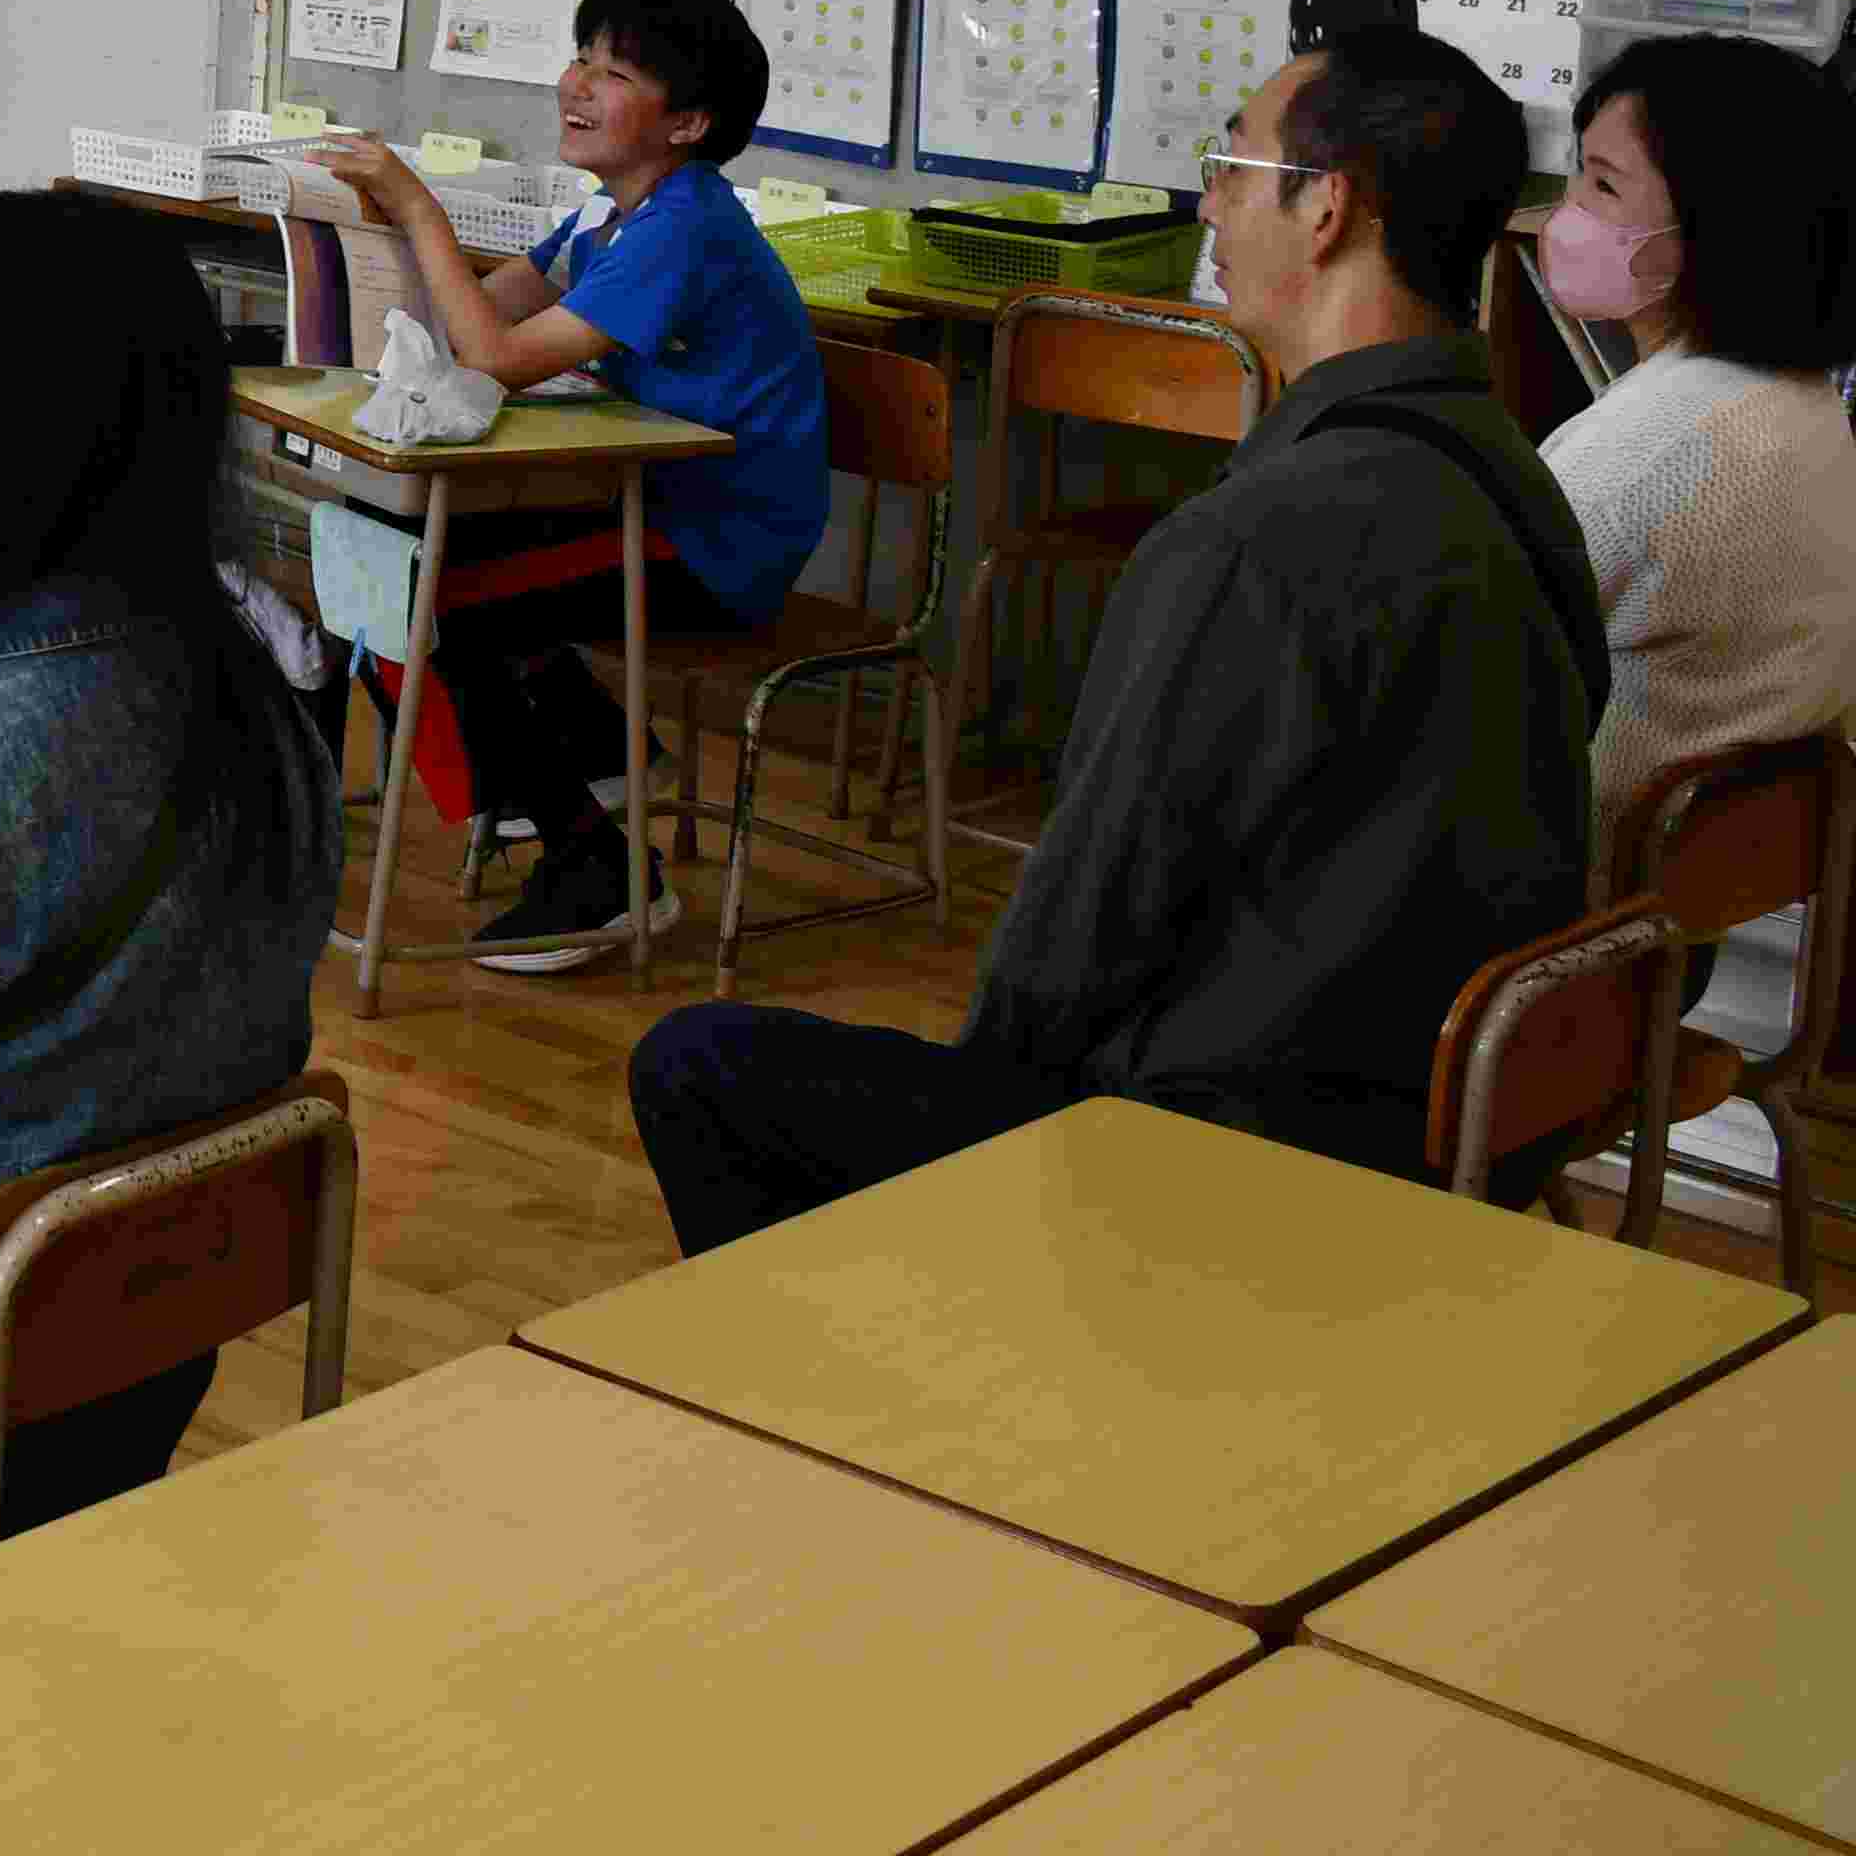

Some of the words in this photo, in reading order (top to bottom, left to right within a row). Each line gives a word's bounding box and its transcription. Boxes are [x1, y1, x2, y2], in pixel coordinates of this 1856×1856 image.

[1556, 1, 1579, 18] 22
[1501, 63, 1523, 79] 28
[1551, 68, 1573, 85] 29
